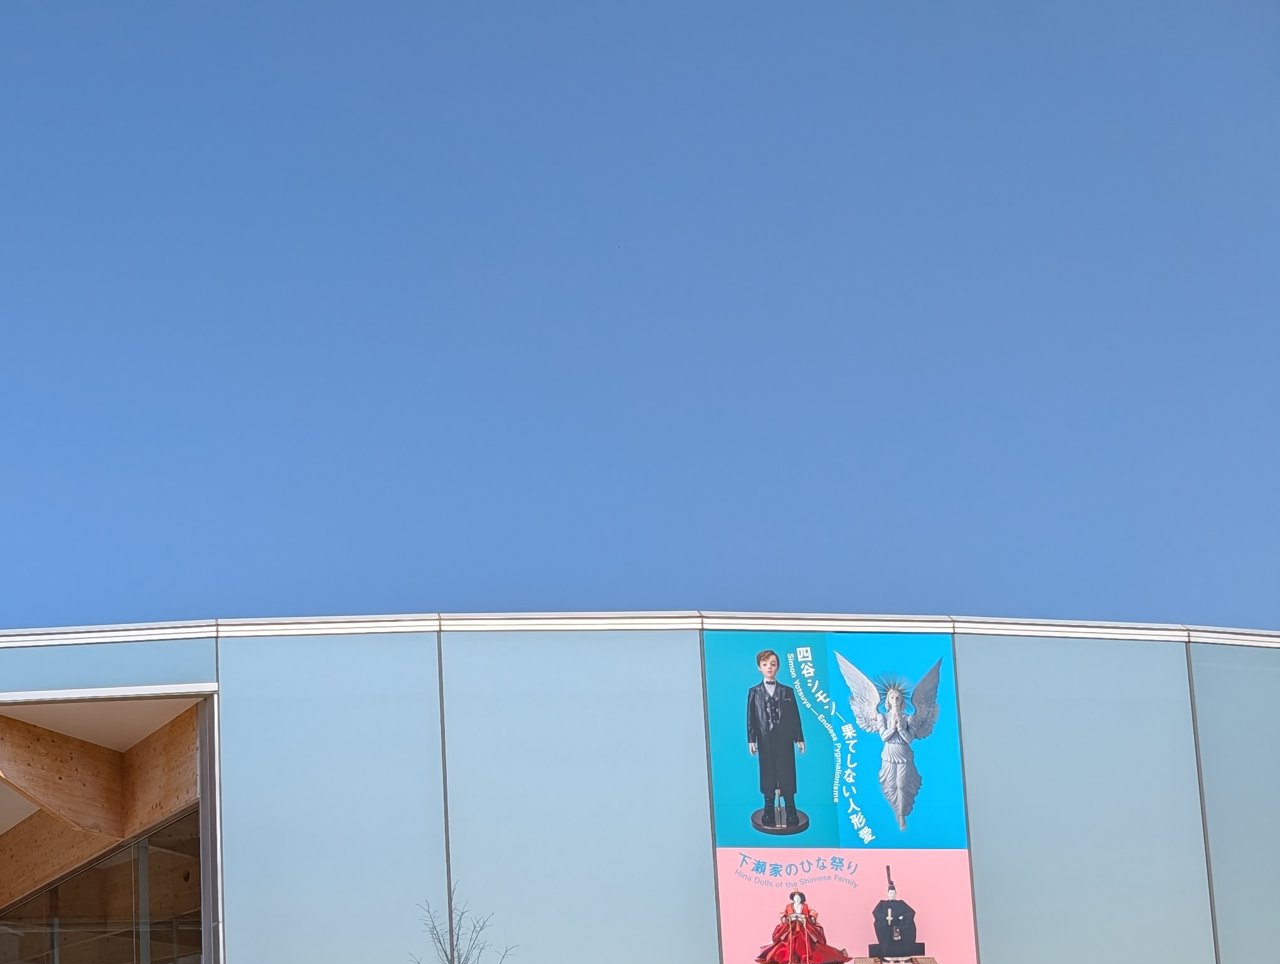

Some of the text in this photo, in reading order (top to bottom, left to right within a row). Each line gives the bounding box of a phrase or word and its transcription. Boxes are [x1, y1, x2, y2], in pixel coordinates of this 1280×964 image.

[787, 653, 797, 678] Simon
[739, 852, 858, 877] 下瀬家のひな祭り
[734, 869, 752, 881] Hina
[754, 876, 773, 887] Dolls
[800, 875, 832, 886] Shimose
[834, 874, 859, 889] Family
